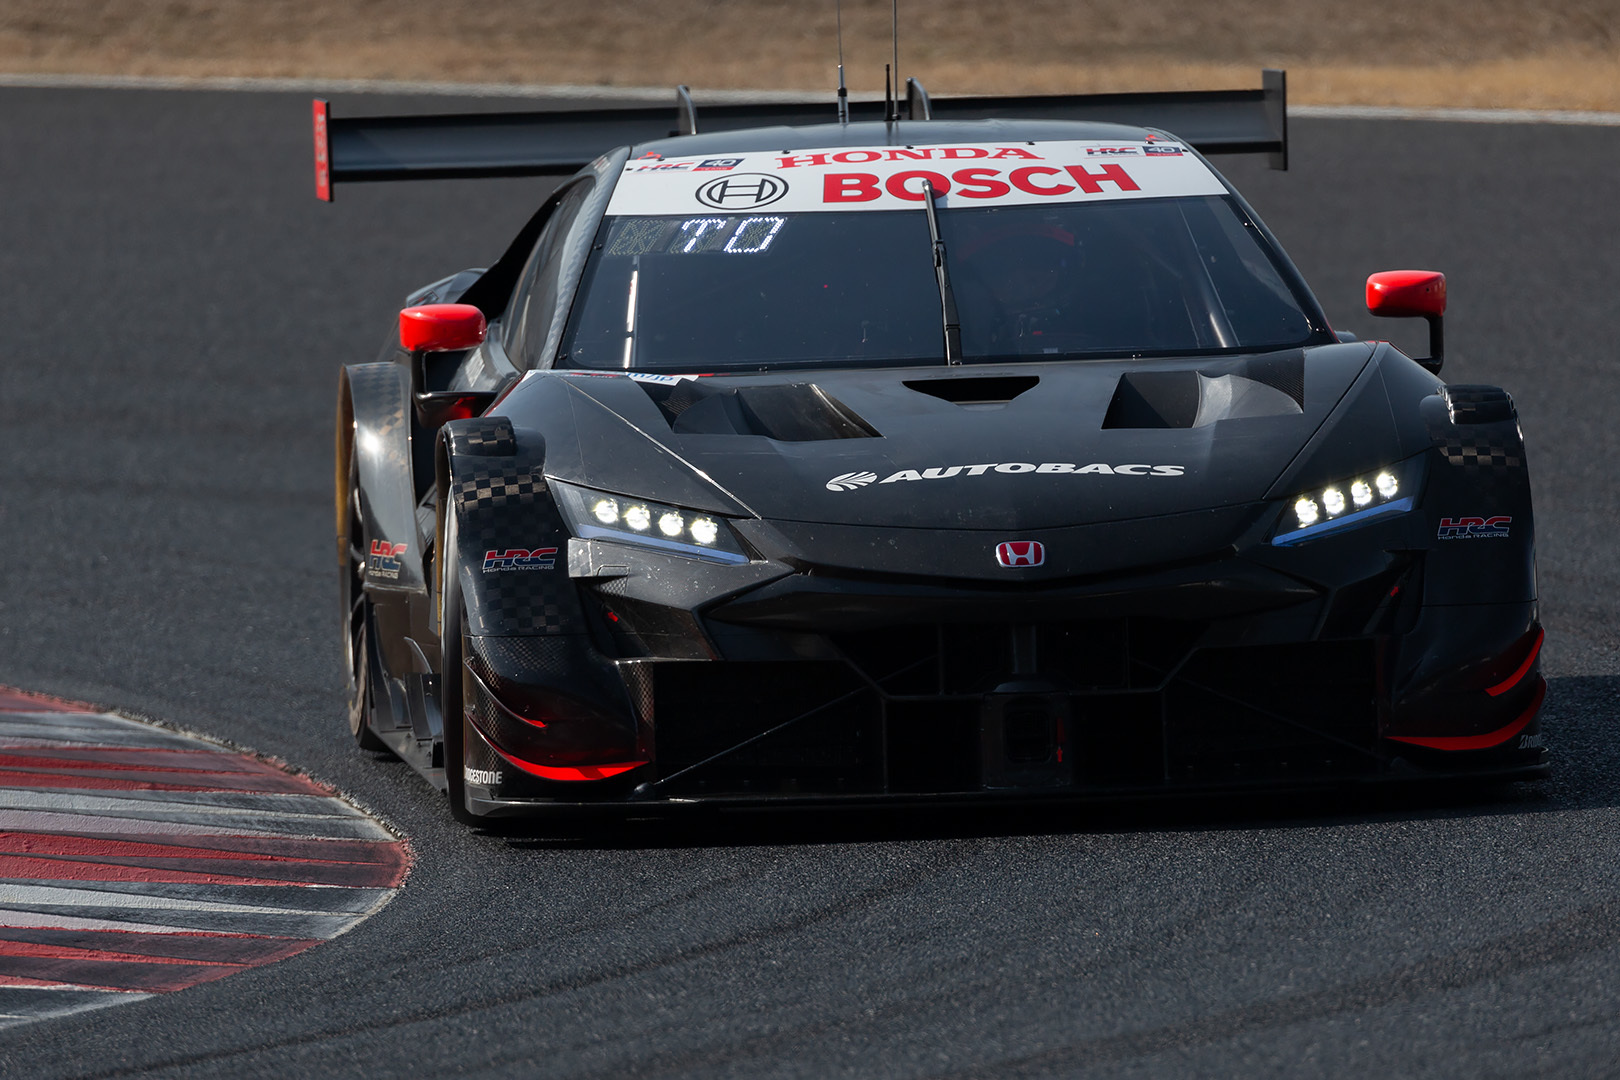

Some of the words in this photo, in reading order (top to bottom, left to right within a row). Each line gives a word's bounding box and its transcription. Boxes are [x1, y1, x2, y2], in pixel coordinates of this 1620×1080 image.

[637, 162, 695, 172] HRC
[775, 147, 1046, 169] HONDA
[822, 163, 1142, 203] BOSCH
[879, 462, 1185, 484] AUTOBACS
[1438, 516, 1512, 536] HRC
[482, 547, 558, 570] HRC
